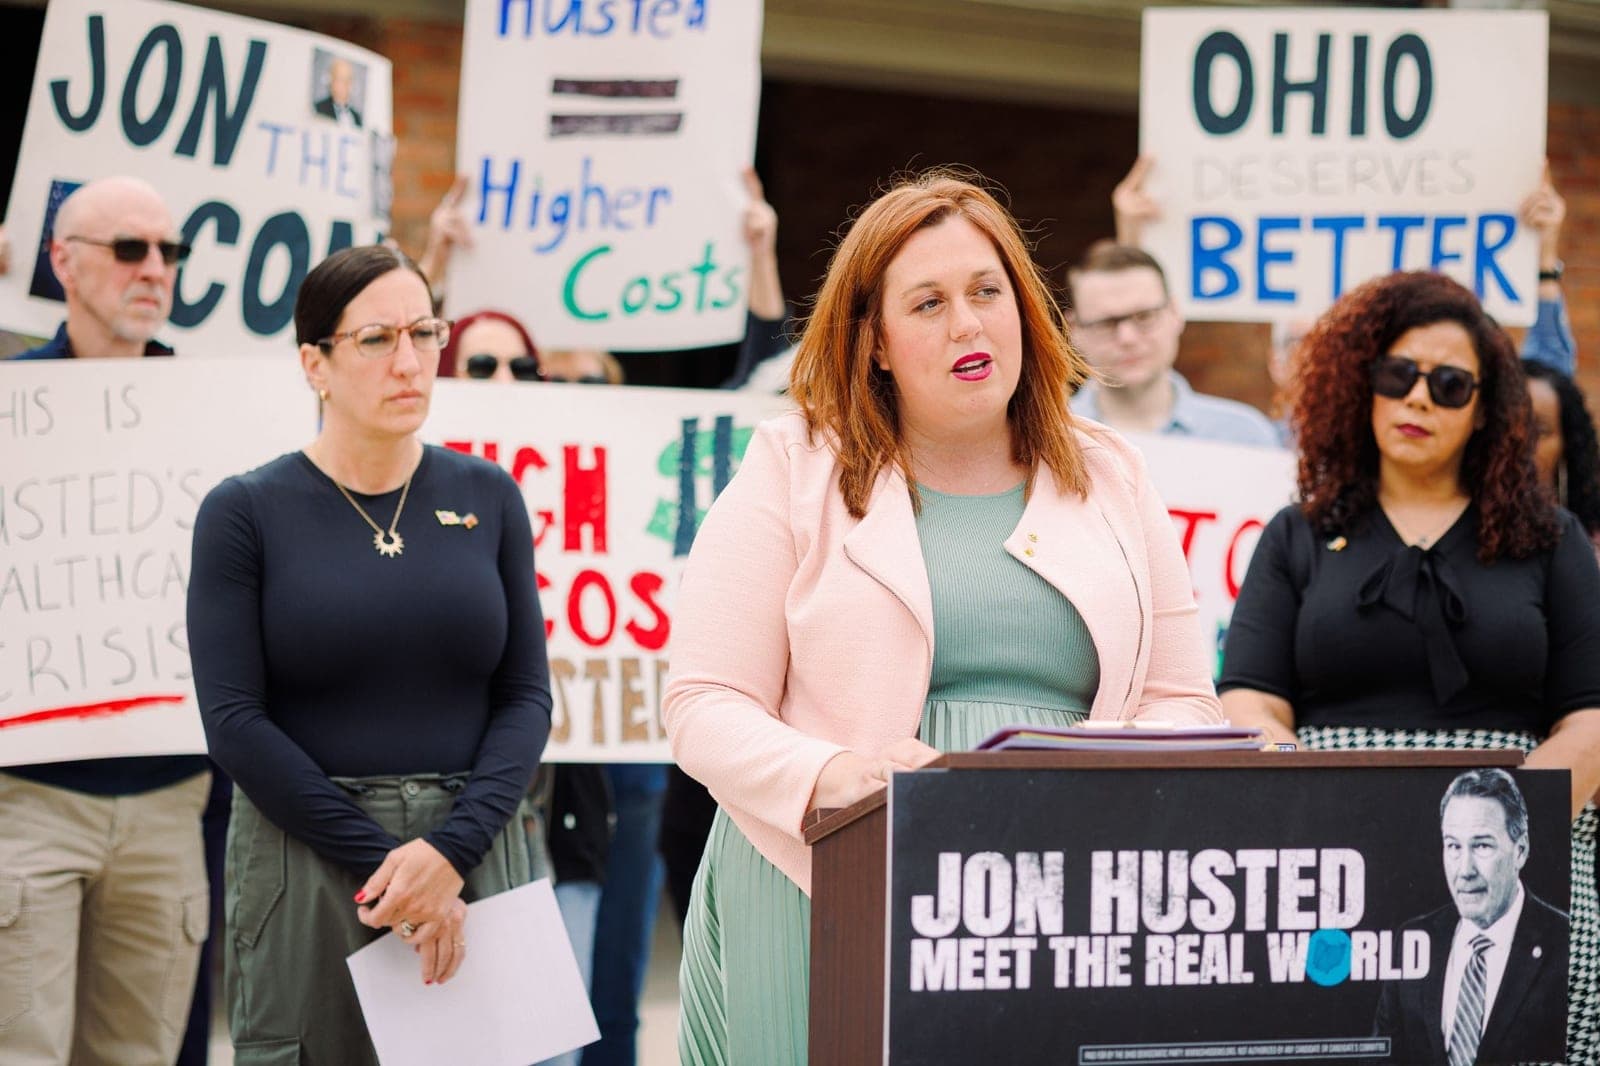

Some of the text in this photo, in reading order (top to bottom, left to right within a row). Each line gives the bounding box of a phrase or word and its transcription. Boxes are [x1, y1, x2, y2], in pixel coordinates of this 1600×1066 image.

[50, 15, 268, 167] JON
[1192, 31, 1434, 139] OHIO
[257, 121, 362, 200] THE
[1191, 148, 1476, 203] DESERVES
[477, 157, 672, 255] Higher
[168, 201, 386, 336] CO
[563, 241, 742, 320] Costs
[0, 384, 142, 438] HIS IS
[0, 622, 192, 698] RISIS
[910, 849, 1366, 938] JON HUSTED
[910, 937, 1037, 991] MEET
[1048, 935, 1132, 988] THE
[1144, 932, 1254, 986] REAL
